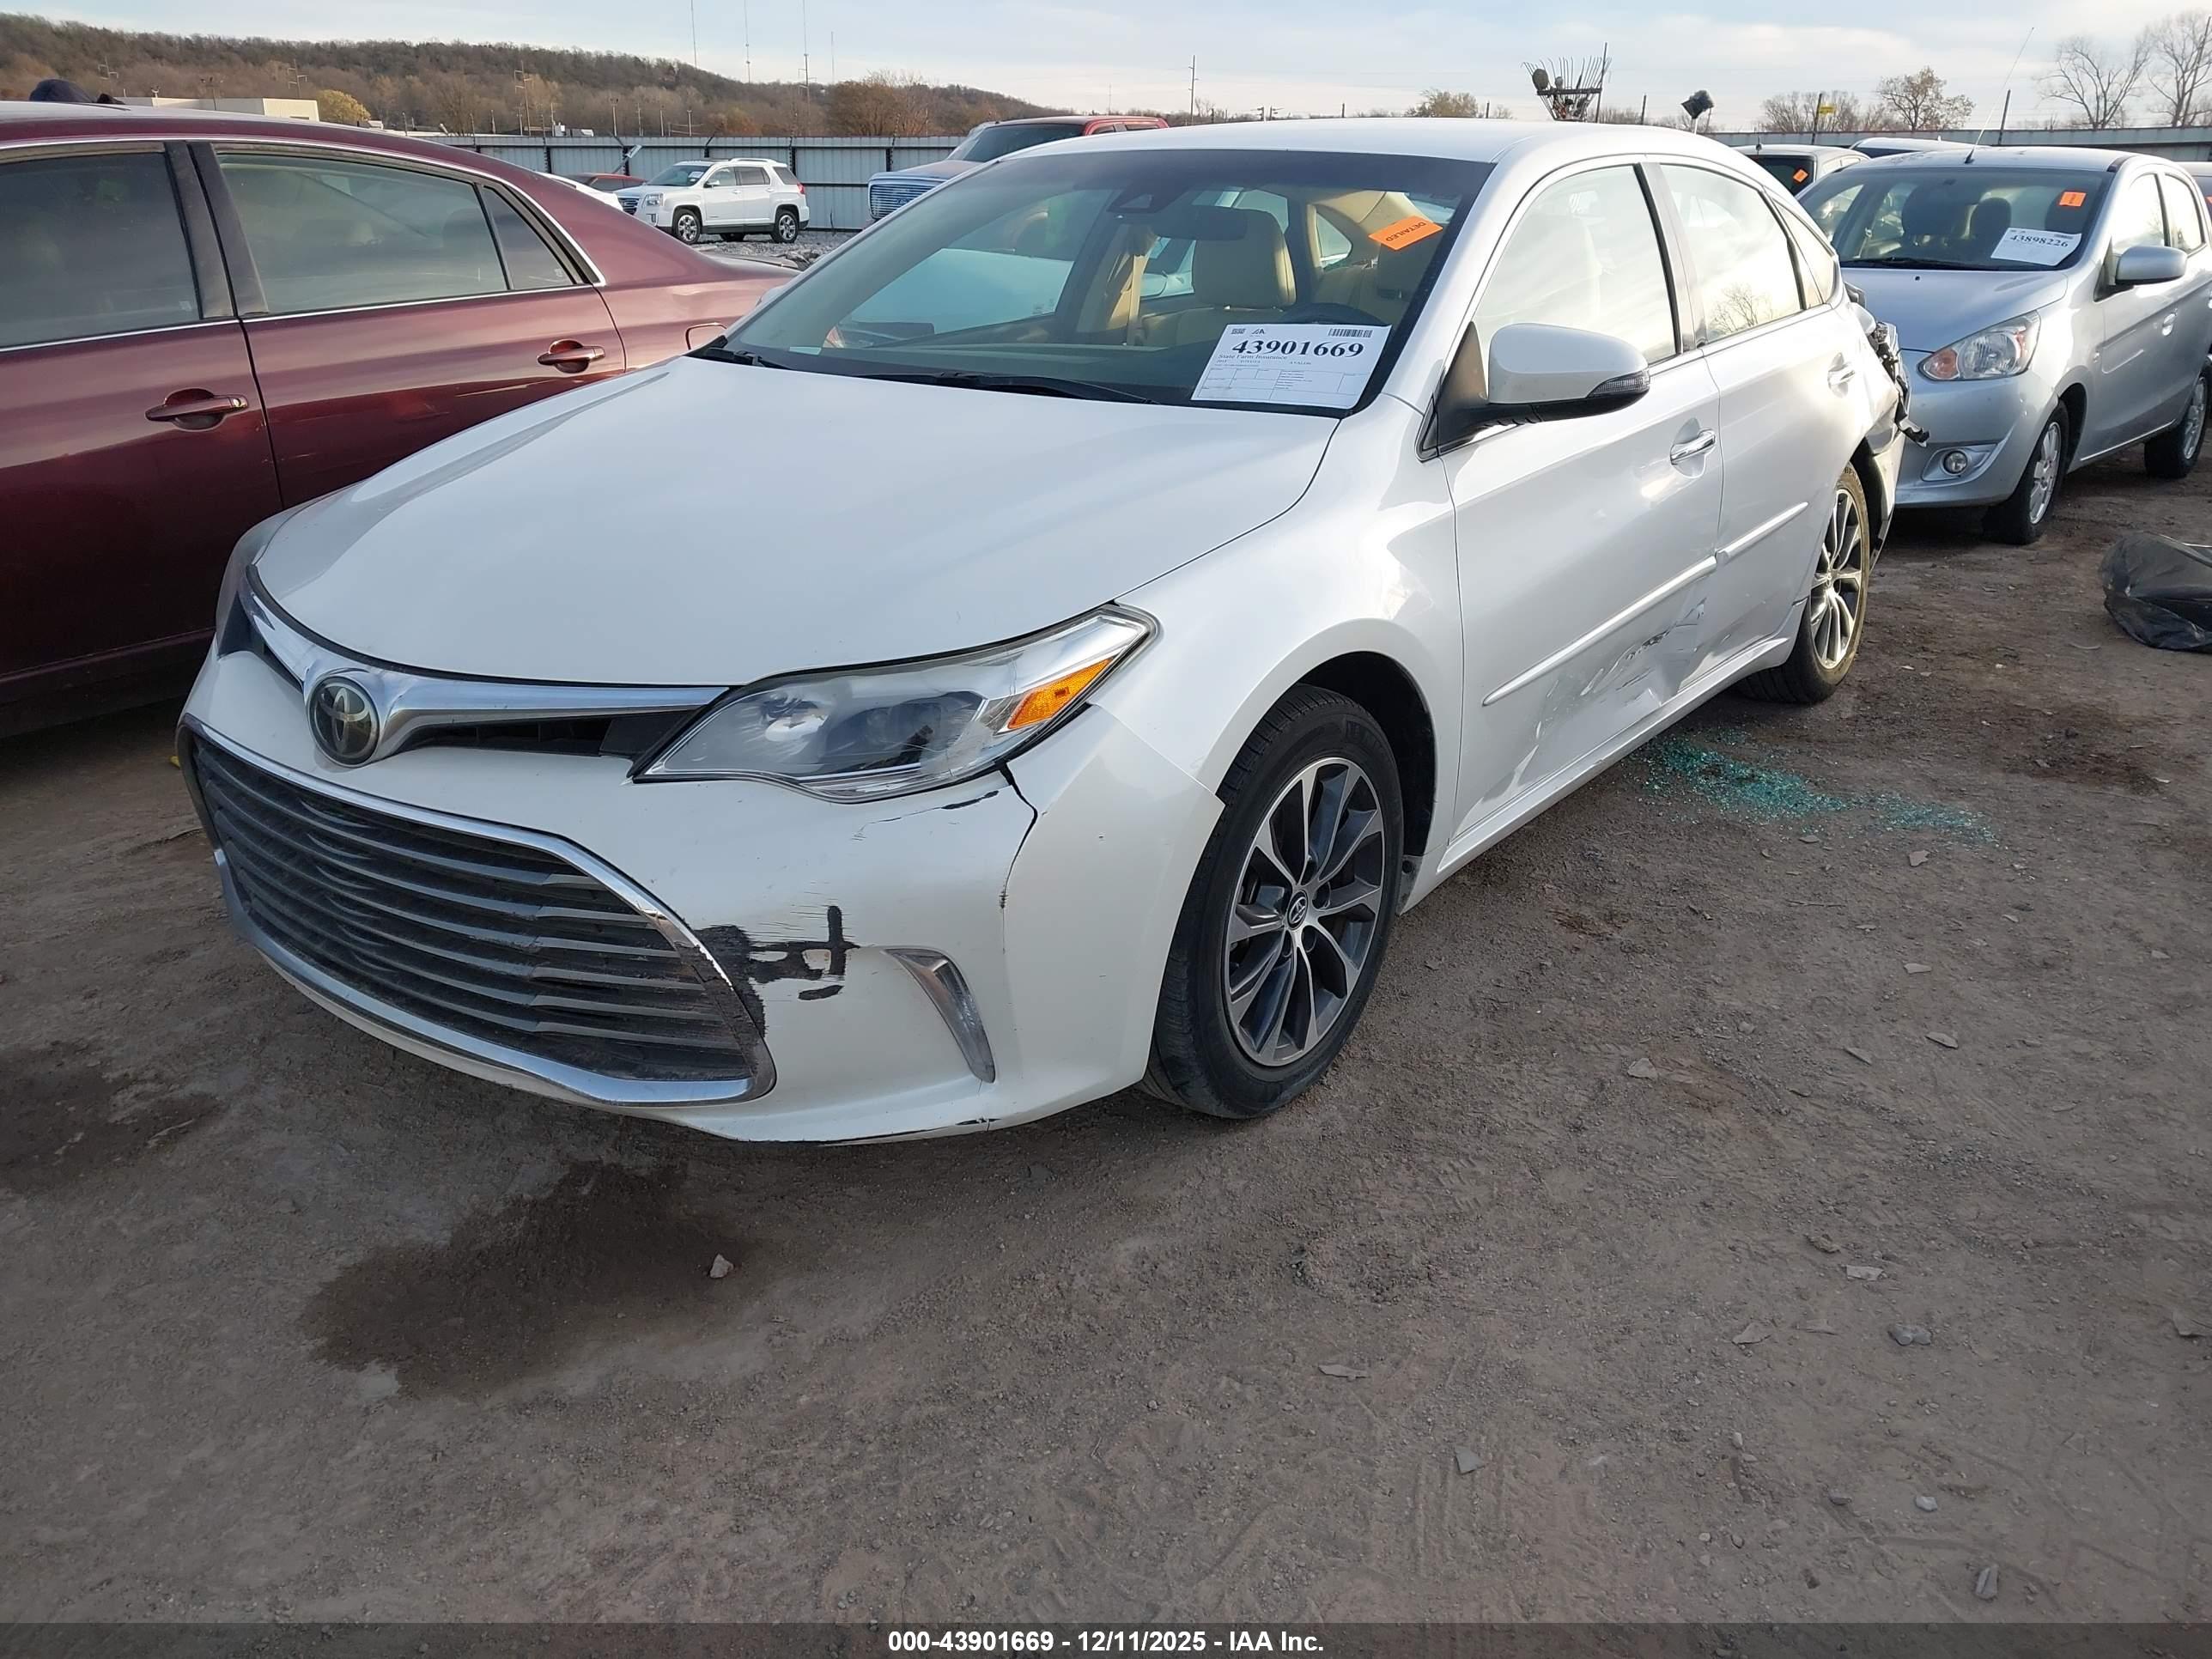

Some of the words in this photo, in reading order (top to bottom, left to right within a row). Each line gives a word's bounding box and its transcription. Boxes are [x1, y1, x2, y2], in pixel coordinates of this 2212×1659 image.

[1386, 222, 1426, 241] DETAILED
[2009, 234, 2069, 247] 43898226
[1231, 339, 1364, 358] 43901669
